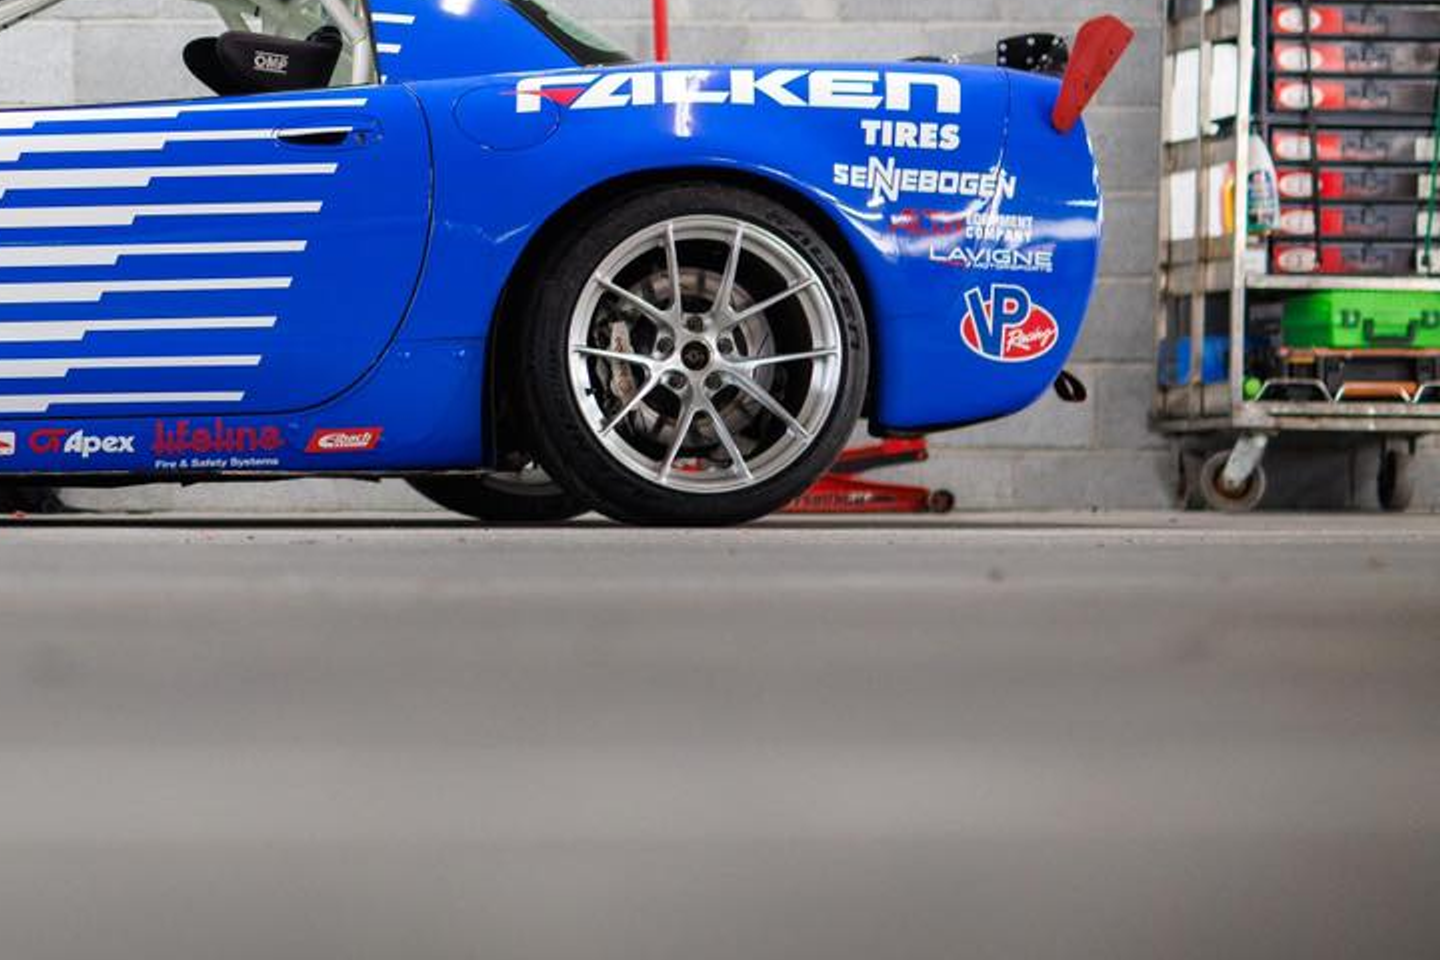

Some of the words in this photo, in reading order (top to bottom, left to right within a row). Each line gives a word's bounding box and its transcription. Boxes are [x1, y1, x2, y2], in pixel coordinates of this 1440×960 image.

[516, 68, 960, 113] FALKEN
[861, 119, 961, 150] TIRES
[929, 244, 1054, 266] LAVIGNE
[964, 284, 1031, 358] VP
[1006, 328, 1057, 353] Racing
[191, 457, 227, 468] Safety
